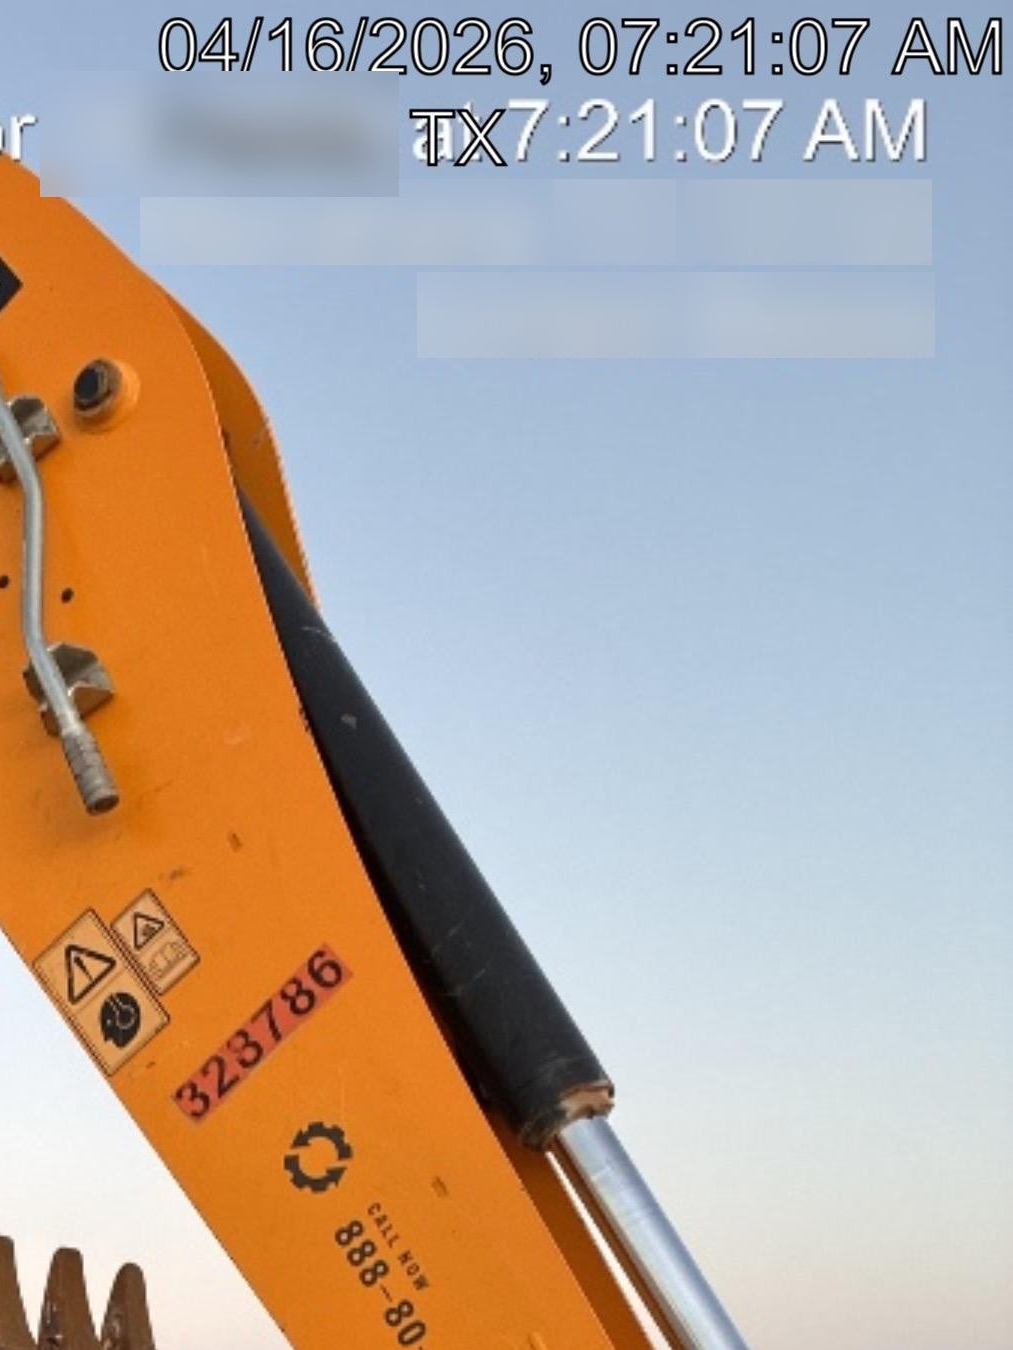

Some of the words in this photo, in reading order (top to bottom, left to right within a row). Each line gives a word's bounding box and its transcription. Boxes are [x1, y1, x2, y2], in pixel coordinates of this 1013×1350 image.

[175, 950, 343, 1119] 323786
[367, 1202, 400, 1249] CALL
[397, 1250, 430, 1291] NOW
